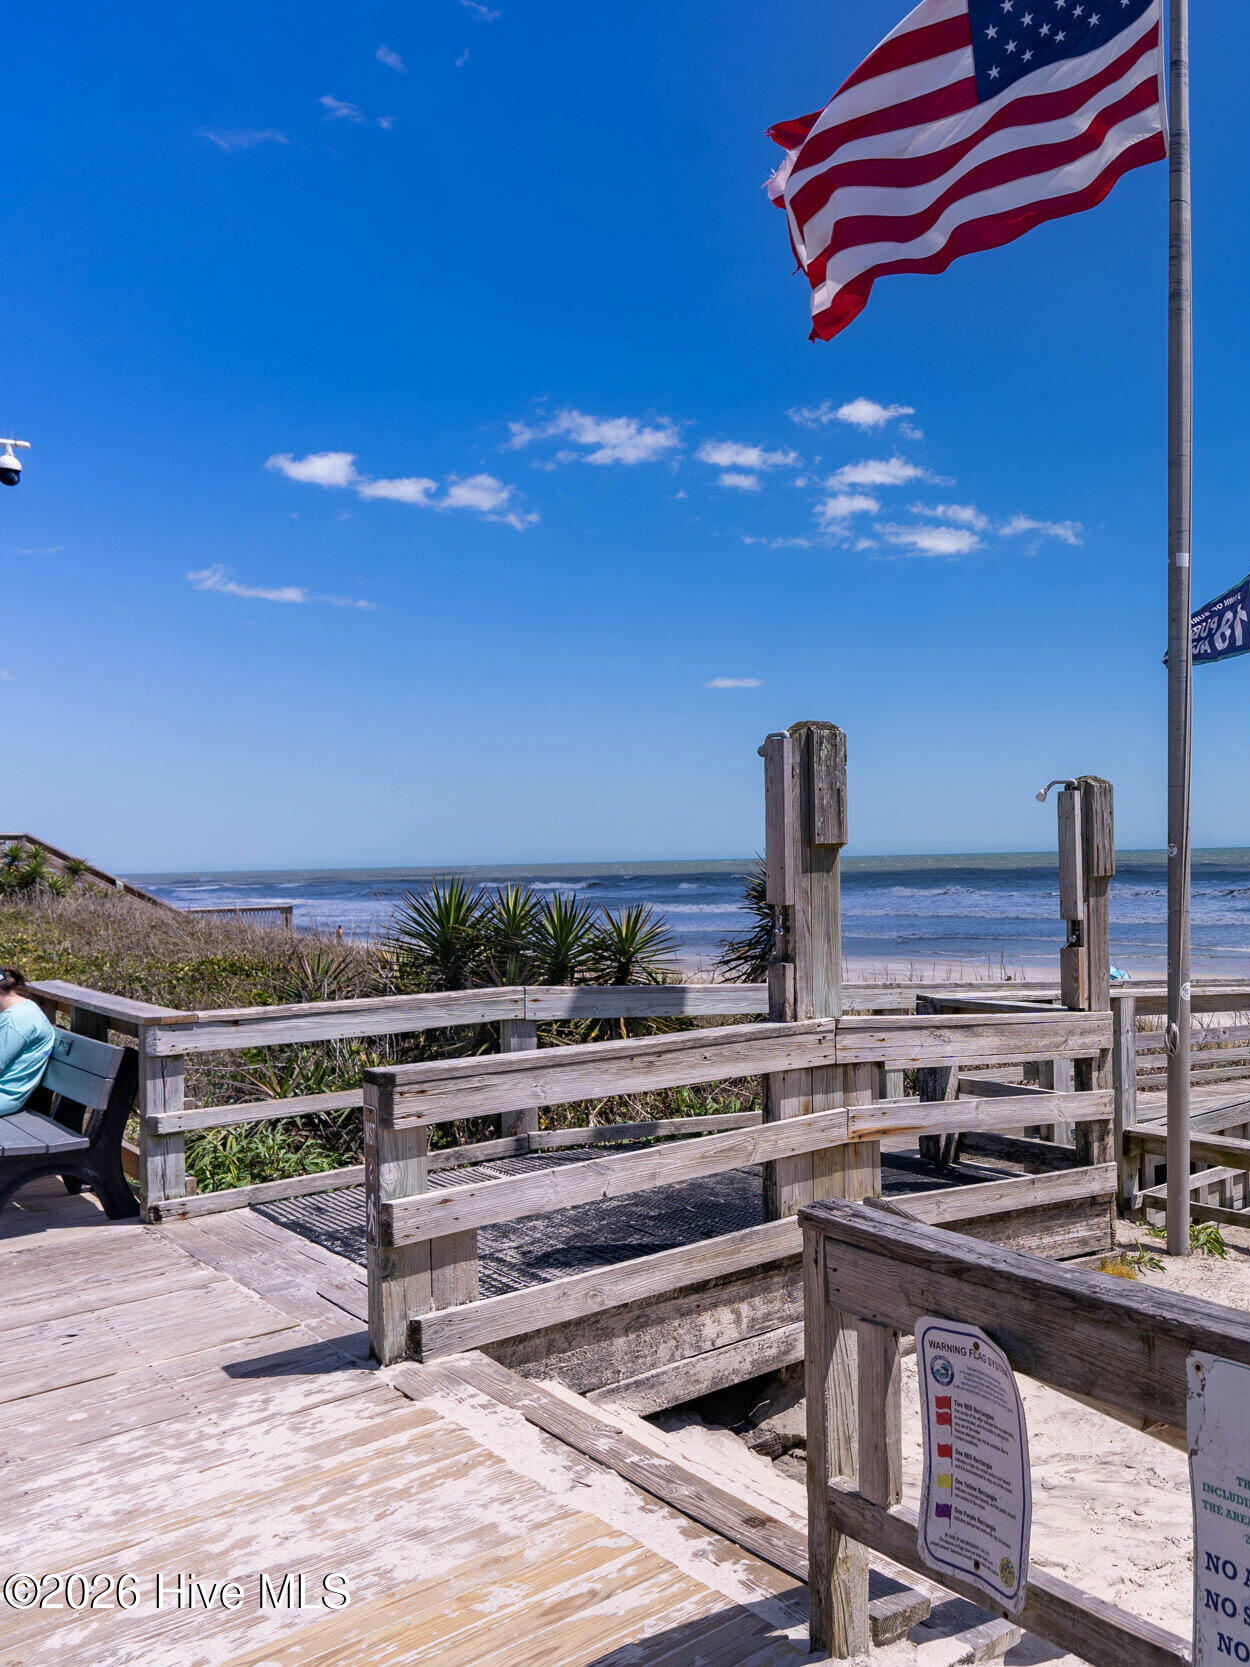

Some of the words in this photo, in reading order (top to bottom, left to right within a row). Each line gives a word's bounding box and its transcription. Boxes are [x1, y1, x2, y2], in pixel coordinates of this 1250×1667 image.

[928, 1340, 966, 1356] WARNING
[1202, 1499, 1223, 1516] THE
[1205, 1551, 1238, 1580] NO
[1205, 1588, 1237, 1618] NO
[1217, 1632, 1250, 1662] NO
